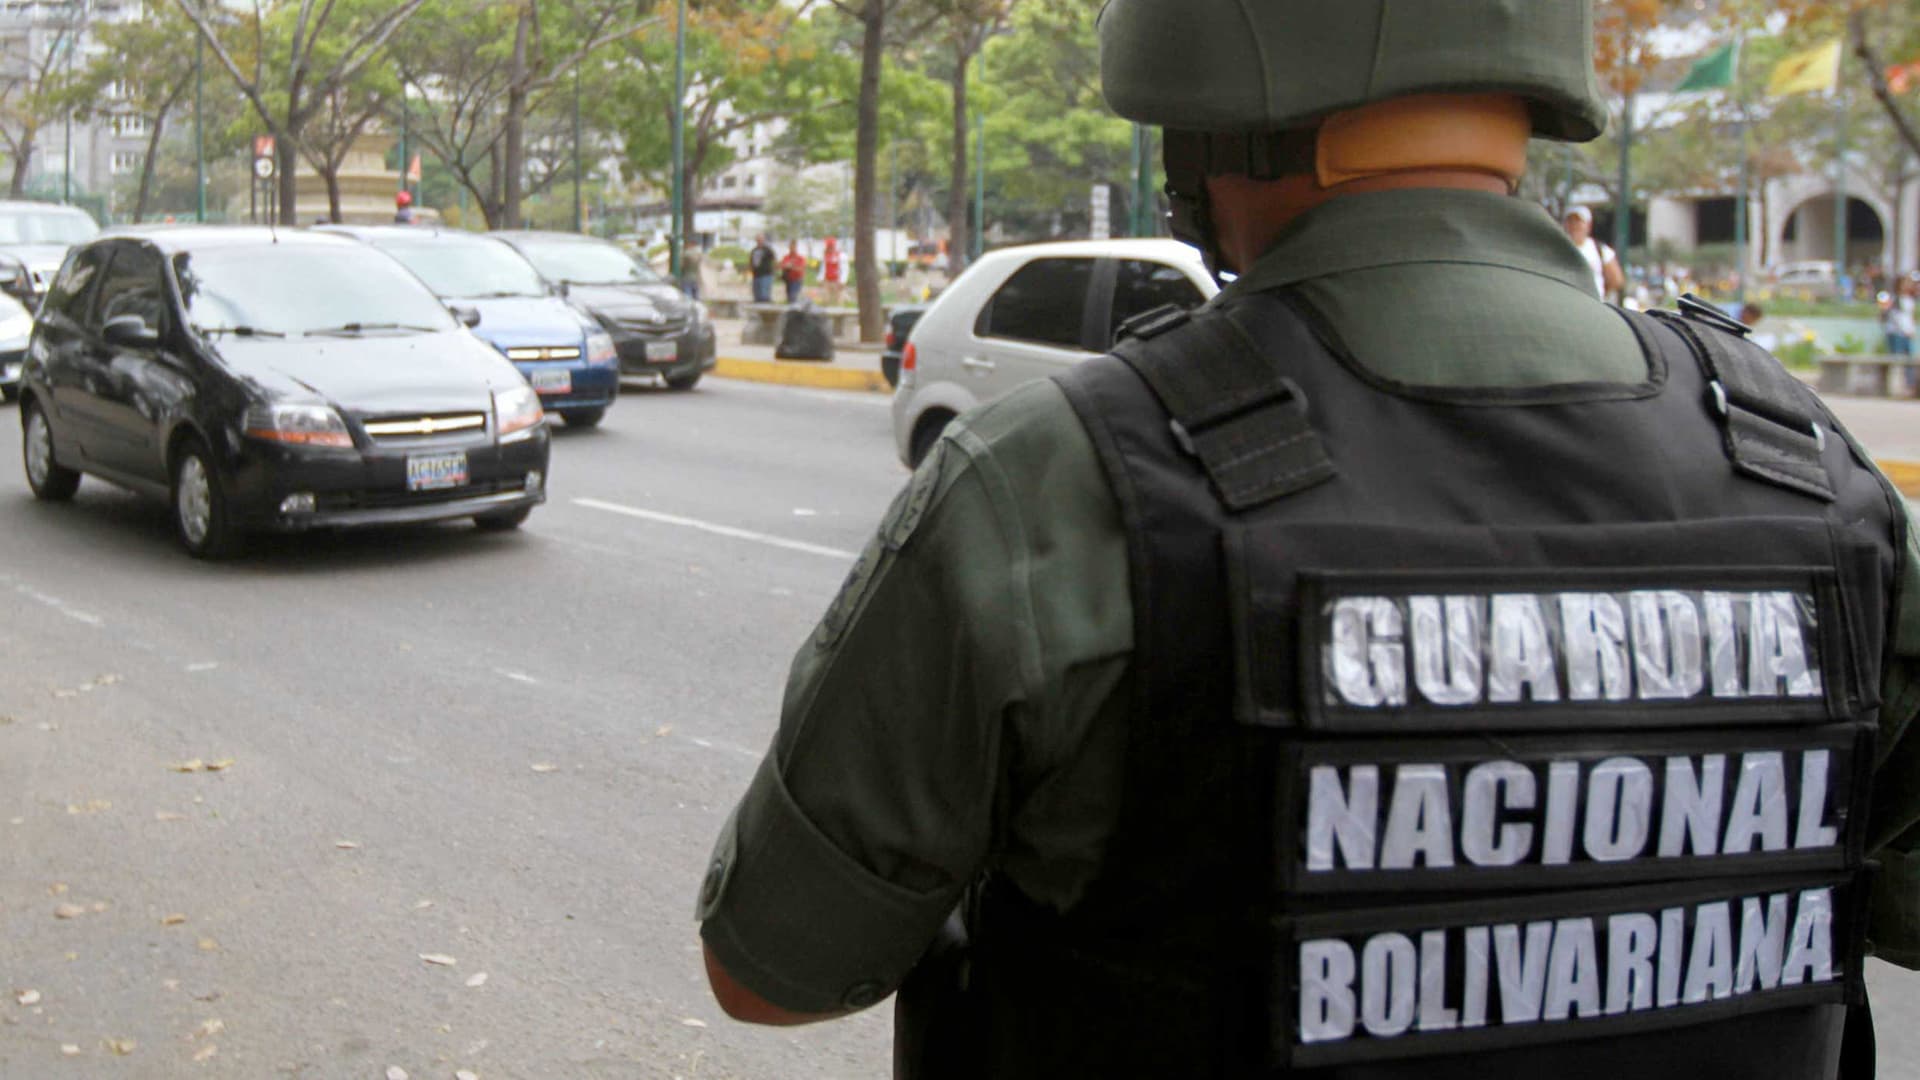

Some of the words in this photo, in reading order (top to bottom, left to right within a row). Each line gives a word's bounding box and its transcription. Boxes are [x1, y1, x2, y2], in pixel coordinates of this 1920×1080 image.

[1329, 590, 1822, 708] GUARDIA
[1306, 749, 1838, 871] NACIONAL
[1299, 887, 1834, 1044] BOLIVARIANA
